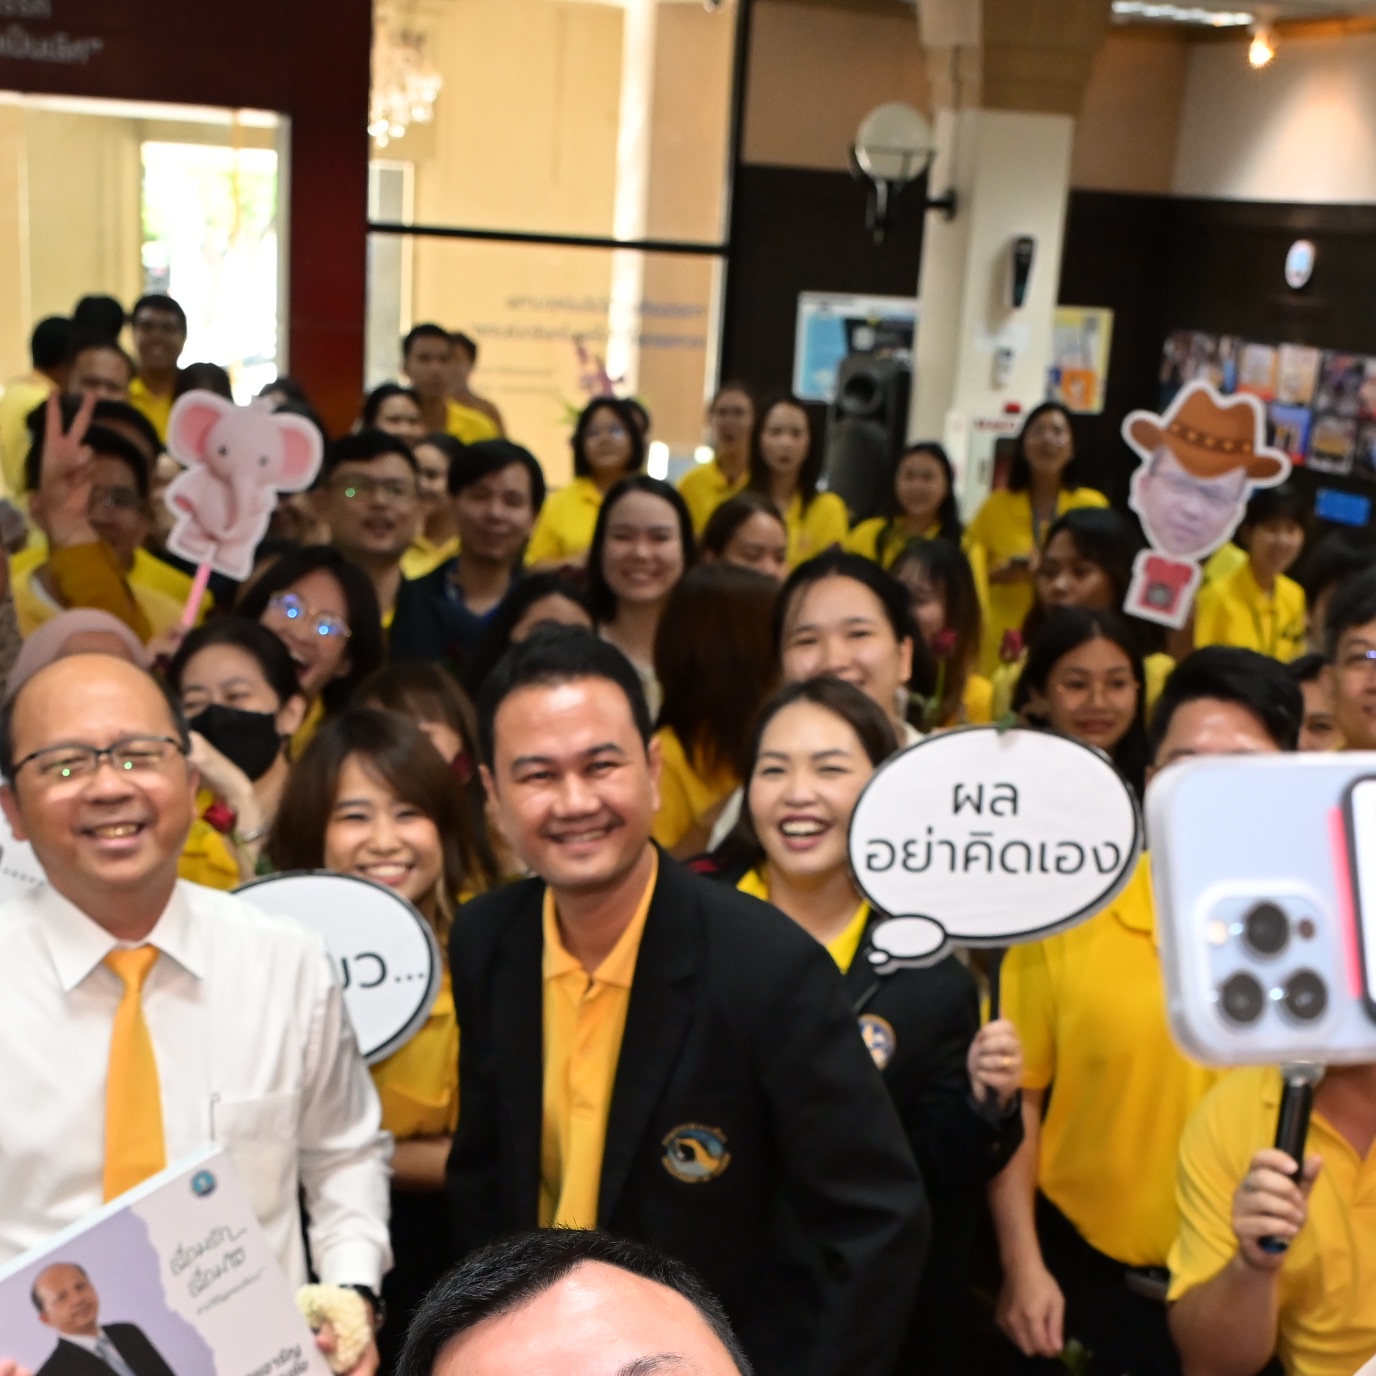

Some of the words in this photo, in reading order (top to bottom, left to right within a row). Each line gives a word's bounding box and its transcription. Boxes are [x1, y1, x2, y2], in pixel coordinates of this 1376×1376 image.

[952, 782, 1019, 816] ผล
[865, 827, 1121, 876] อย่าคิดเอง
